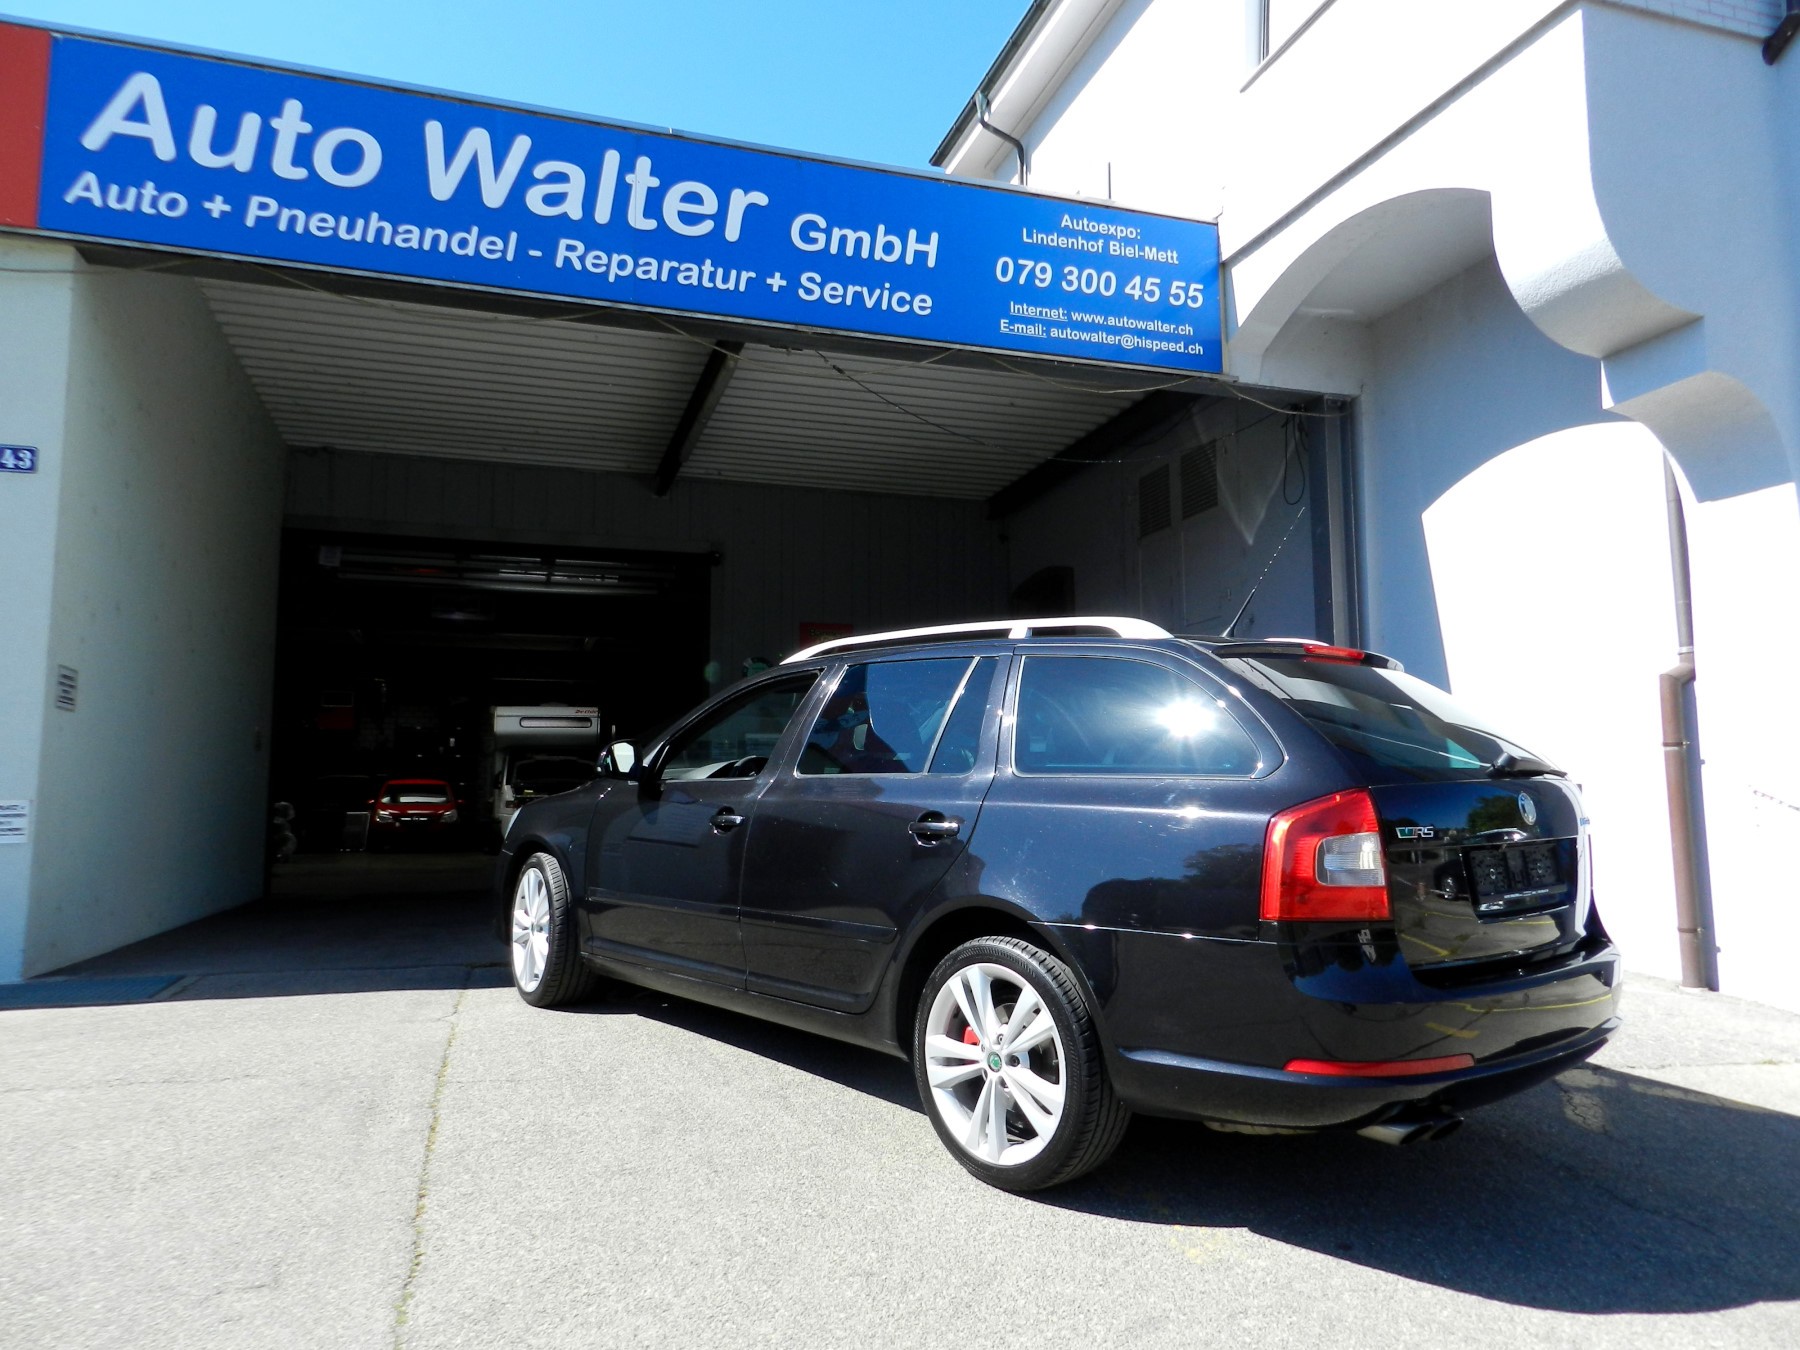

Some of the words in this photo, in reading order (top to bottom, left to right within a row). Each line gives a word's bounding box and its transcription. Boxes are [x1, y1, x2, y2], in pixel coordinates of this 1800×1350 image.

[81, 71, 383, 189] Auto
[424, 119, 770, 243] Walter
[789, 213, 940, 269] GmbH
[63, 171, 189, 218] Auto
[202, 195, 232, 219] +
[244, 194, 518, 262] Pneuhandel
[554, 237, 757, 293] Reparatur
[765, 271, 788, 293] +
[797, 271, 934, 317] Service
[1060, 213, 1142, 240] Autoexpo:
[1022, 227, 1104, 253] Lindenhof
[1108, 240, 1179, 265] Biel-Mett
[995, 256, 1053, 288] 079
[1061, 265, 1117, 297] 300
[1124, 275, 1161, 303] 45
[1168, 280, 1204, 309] 55
[1010, 301, 1068, 321] Internet:
[1070, 310, 1194, 336] www.autowalter.ch
[1000, 319, 1047, 337] E-mail:
[1050, 326, 1204, 356] autowalter@hispeed.ch
[1, 448, 33, 470] 43
